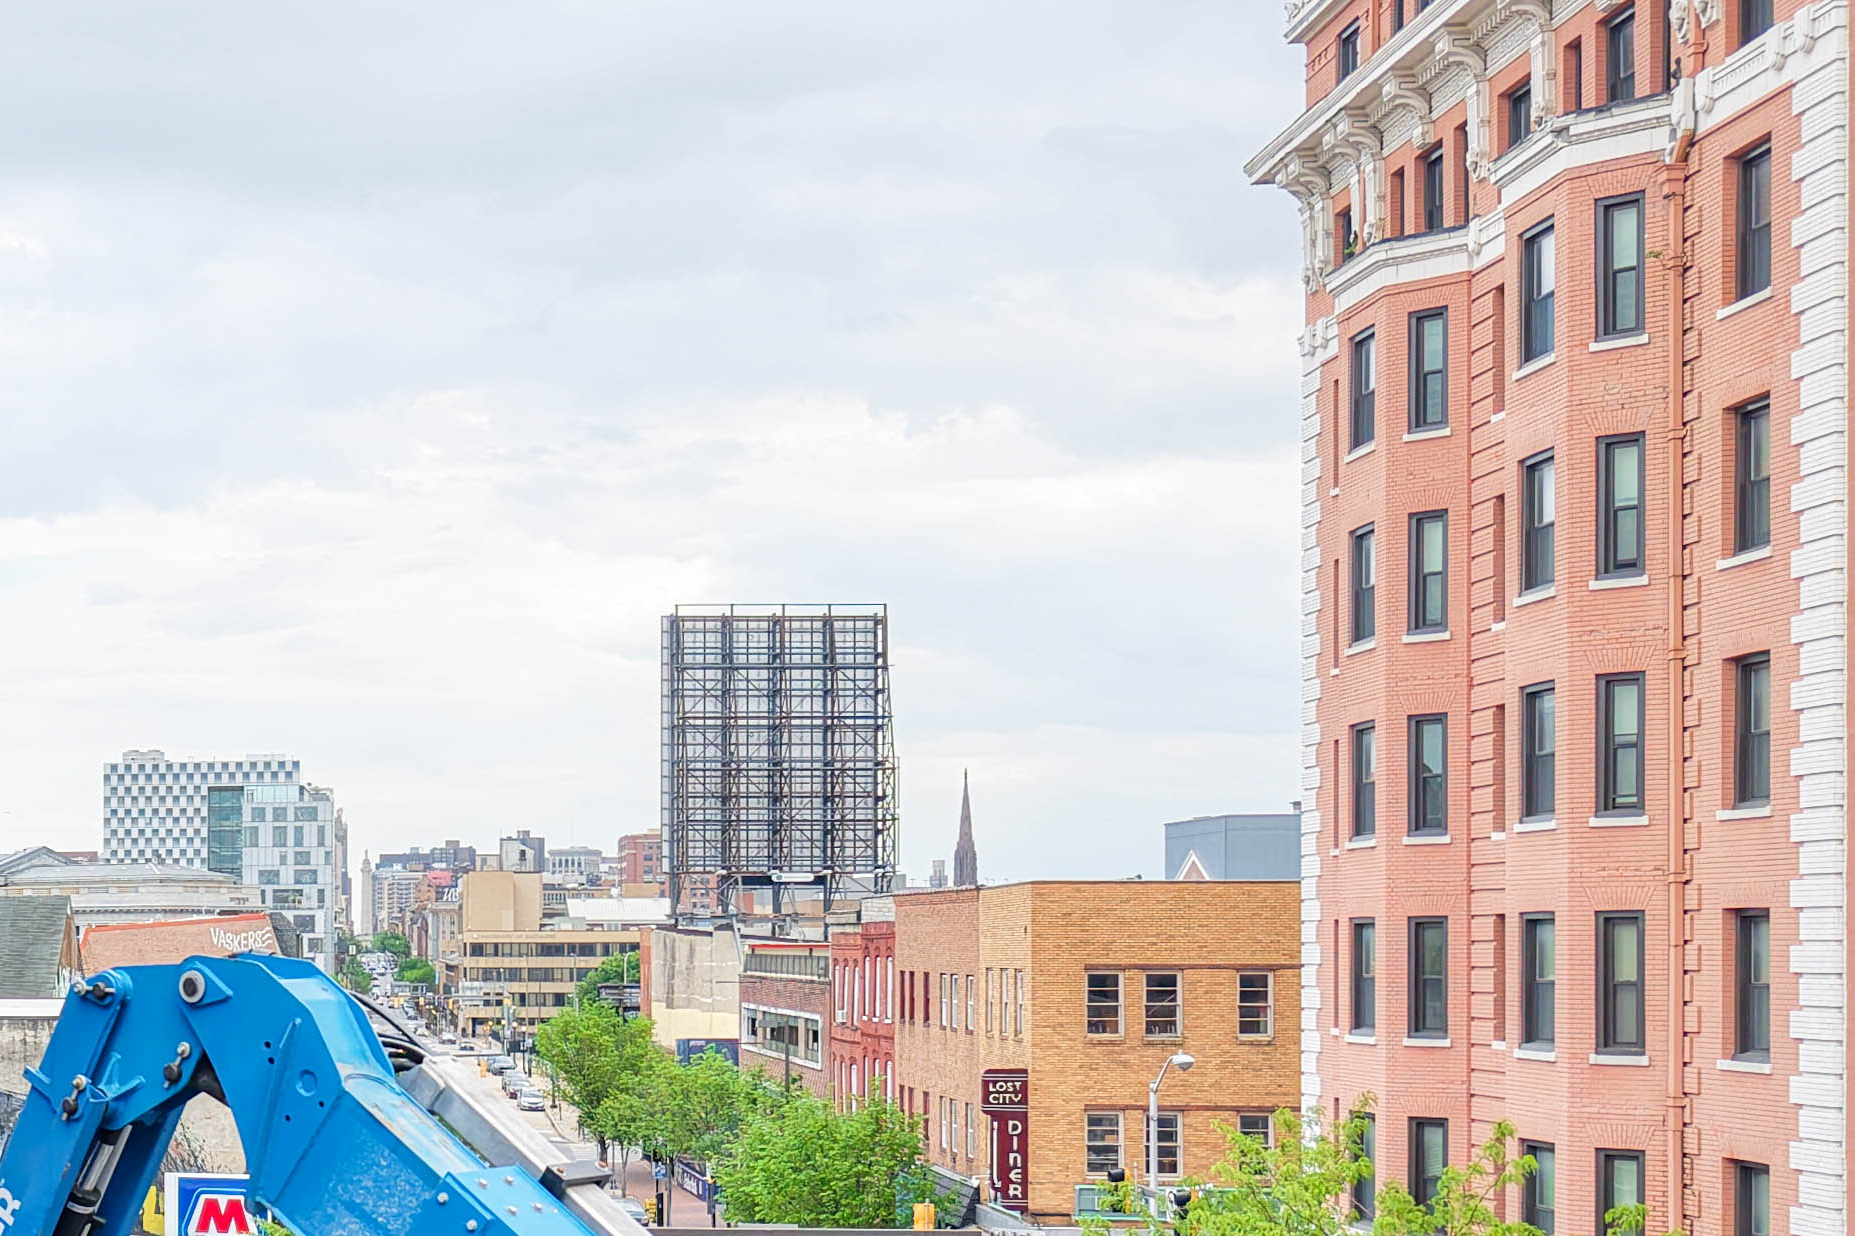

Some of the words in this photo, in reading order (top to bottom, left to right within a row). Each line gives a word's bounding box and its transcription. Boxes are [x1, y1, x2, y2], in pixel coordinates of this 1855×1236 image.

[988, 1081, 1022, 1092] LOST
[988, 1093, 1022, 1104] CITY
[1007, 1119, 1023, 1199] DINER
